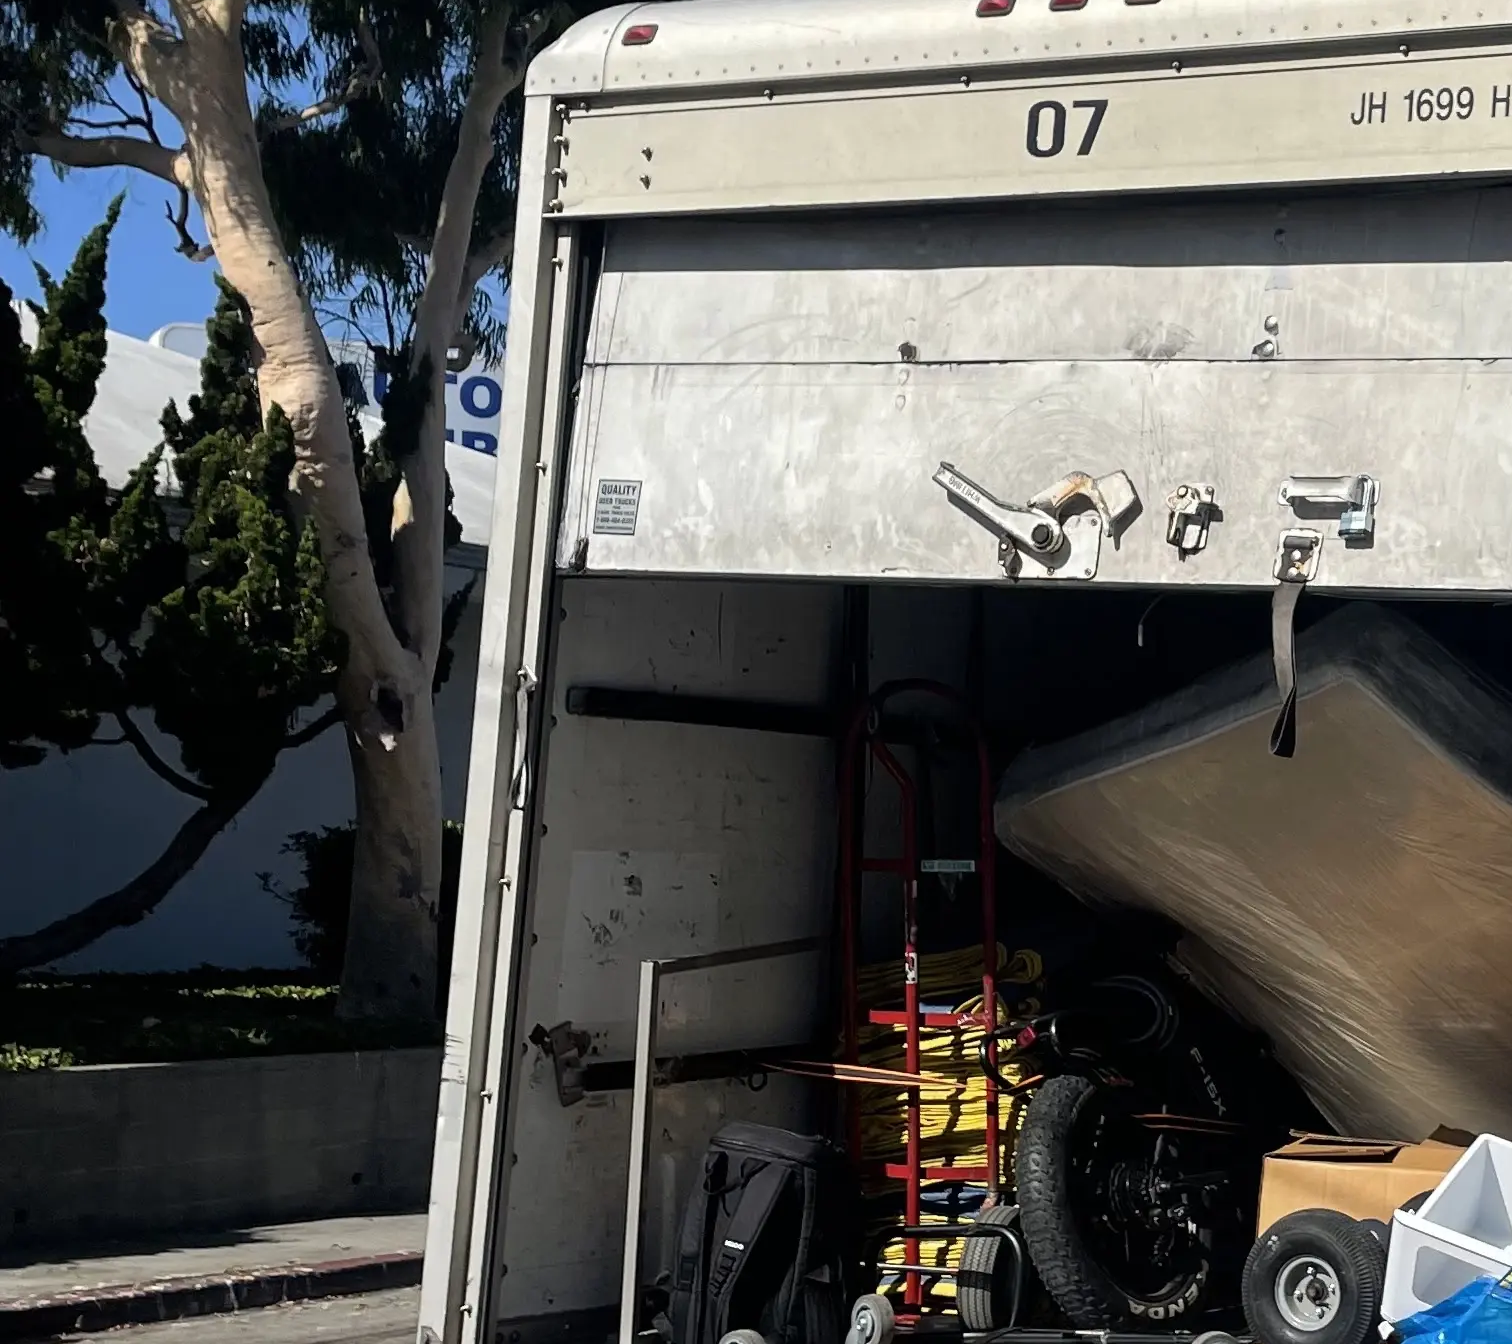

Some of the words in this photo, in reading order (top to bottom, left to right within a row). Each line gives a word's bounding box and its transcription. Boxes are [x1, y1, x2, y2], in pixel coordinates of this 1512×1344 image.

[1350, 91, 1387, 125] JH
[1404, 86, 1475, 122] 1699
[1491, 84, 1511, 118] H
[1026, 99, 1109, 158] 07
[601, 484, 637, 496] QUALITY
